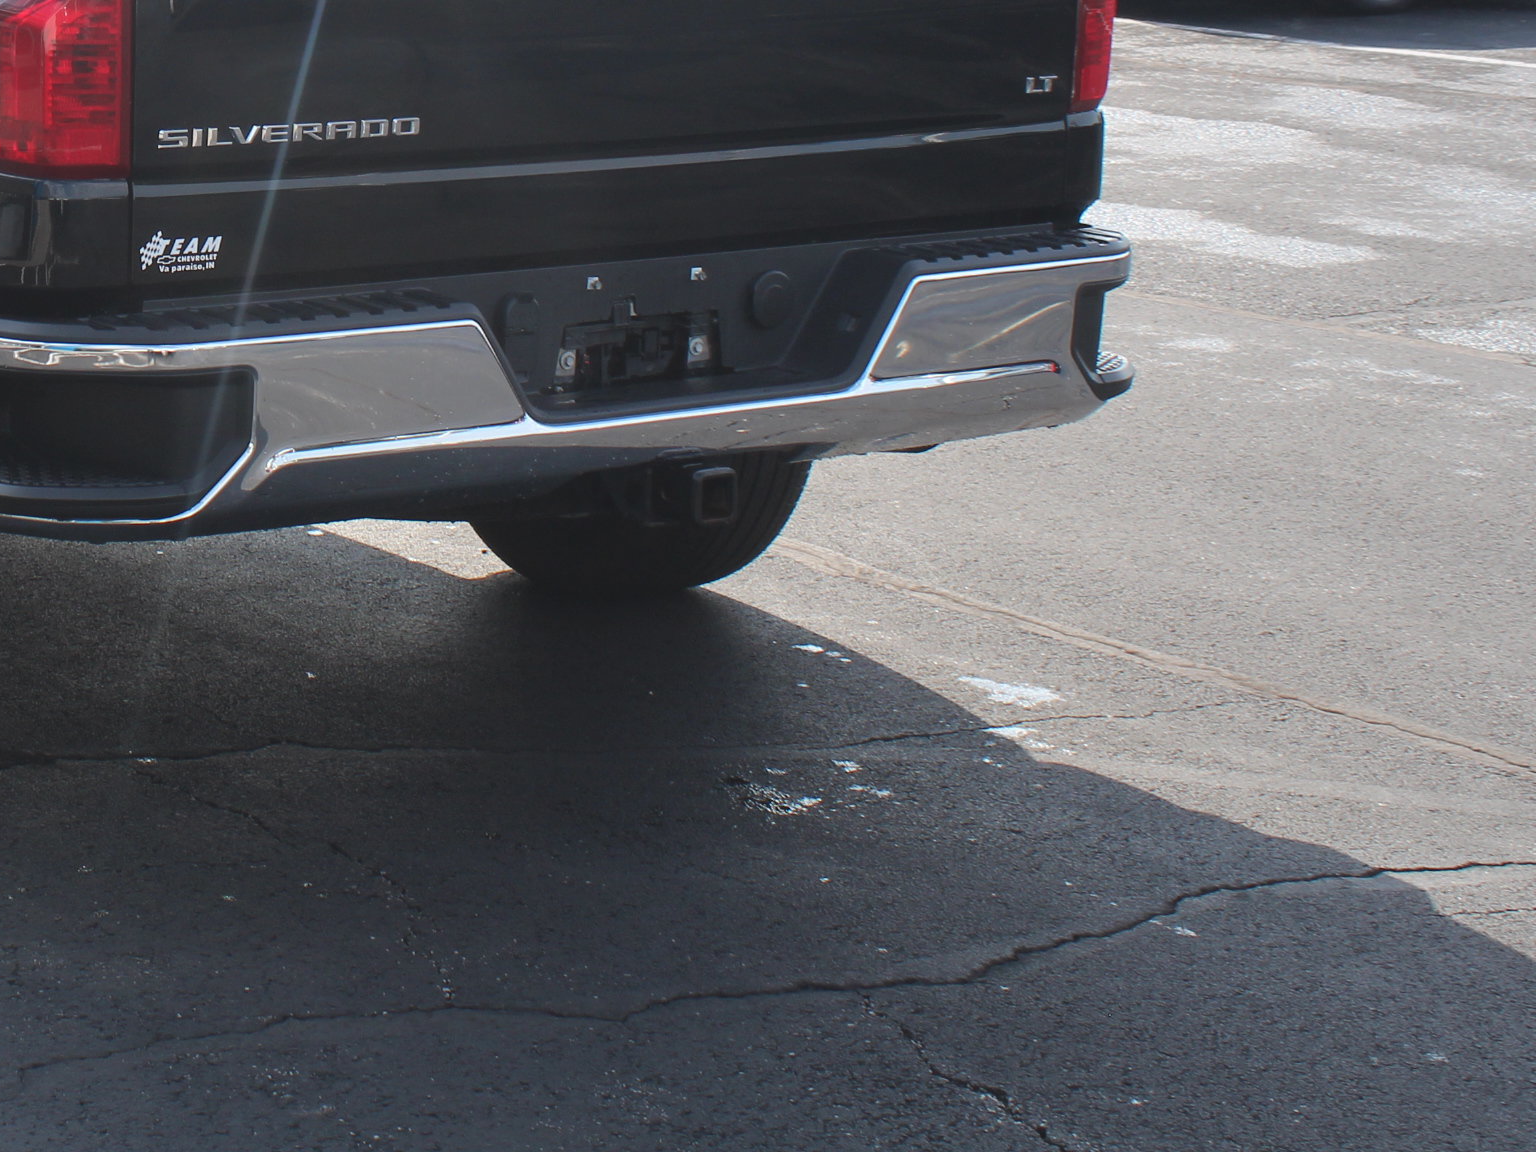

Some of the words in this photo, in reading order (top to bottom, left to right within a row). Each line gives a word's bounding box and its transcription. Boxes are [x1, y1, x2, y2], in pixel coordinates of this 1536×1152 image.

[1025, 75, 1058, 94] LT
[157, 116, 421, 149] SILVERADO
[156, 236, 222, 255] TEAM
[177, 254, 217, 262] CHEVROLET
